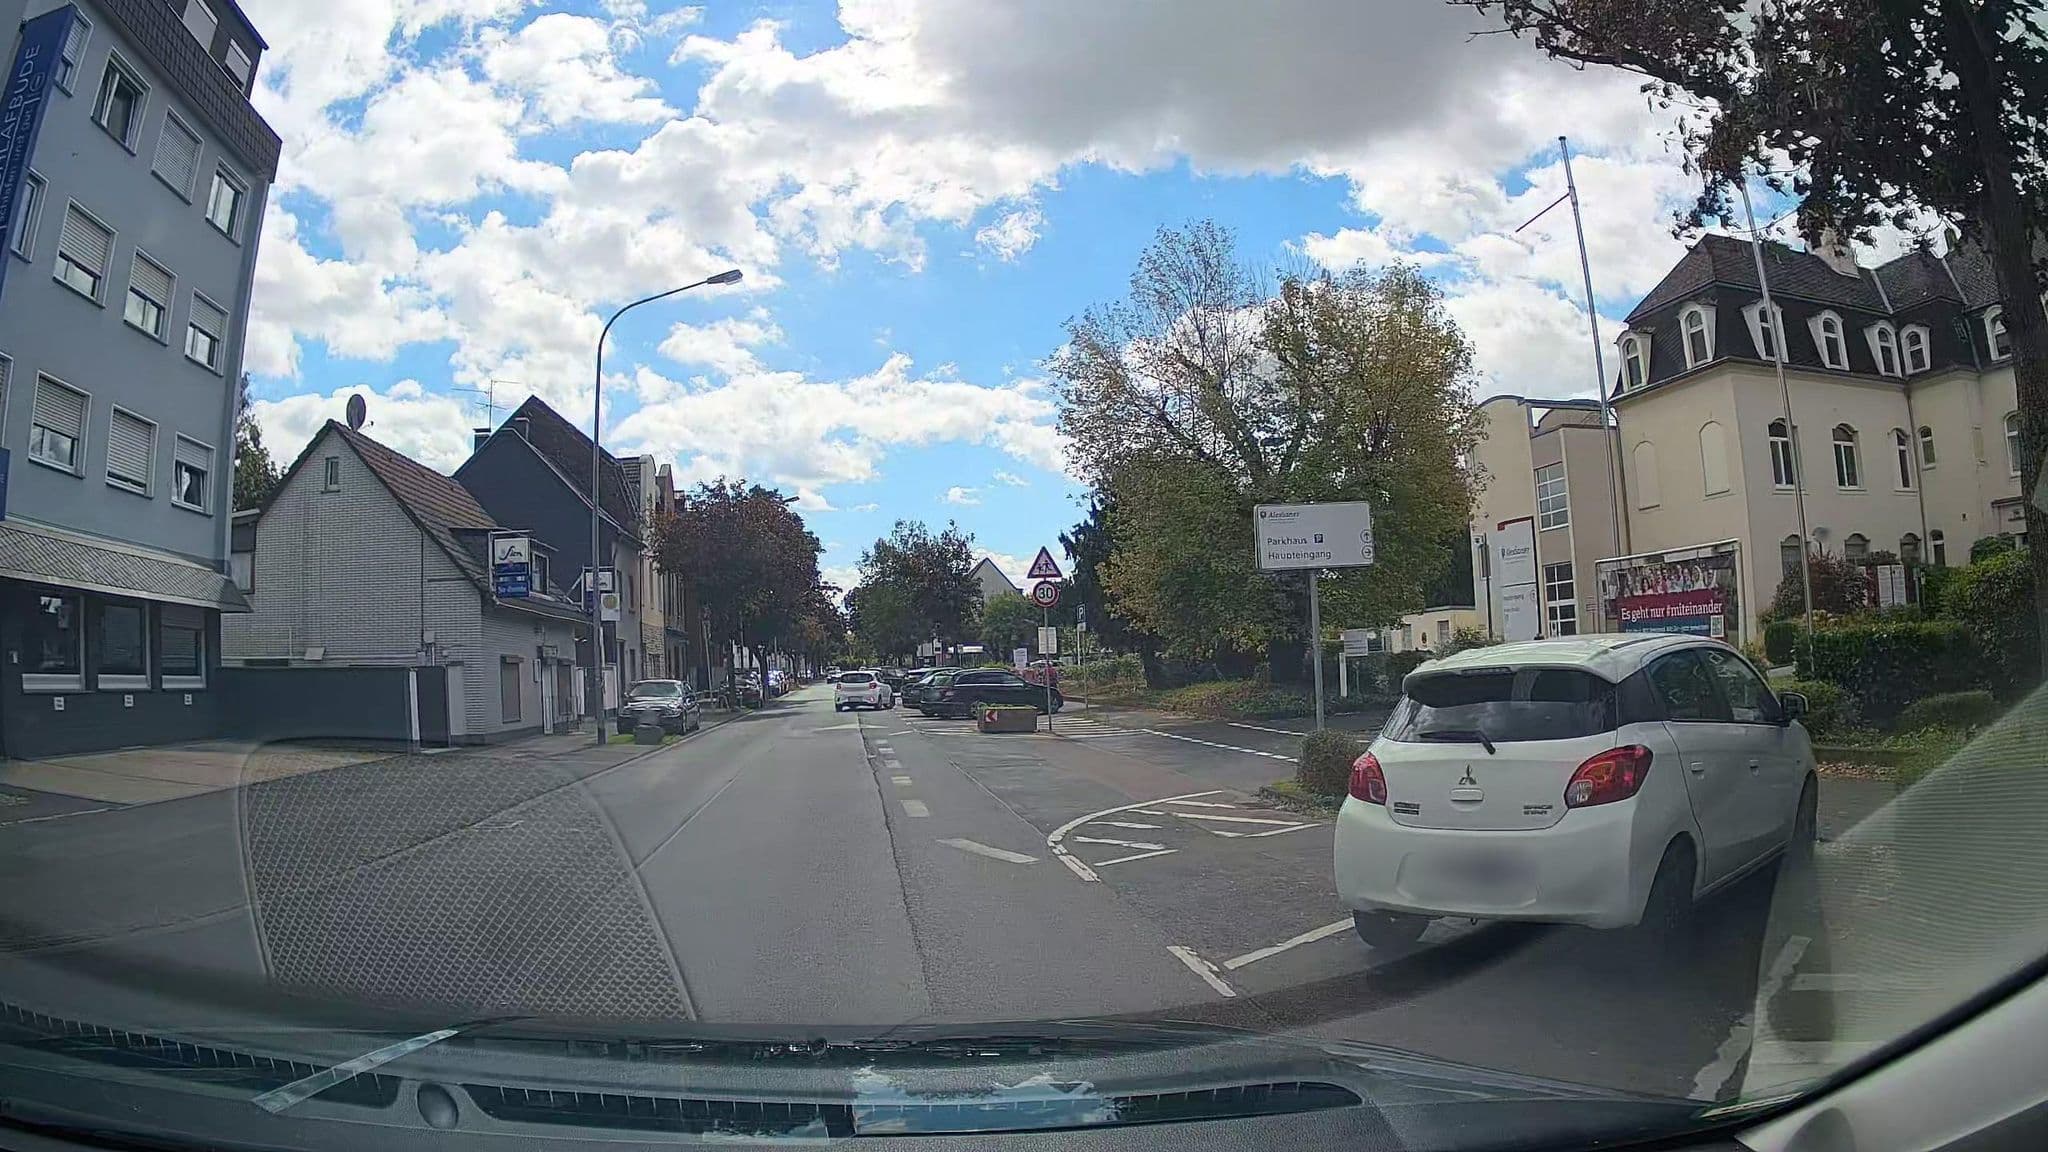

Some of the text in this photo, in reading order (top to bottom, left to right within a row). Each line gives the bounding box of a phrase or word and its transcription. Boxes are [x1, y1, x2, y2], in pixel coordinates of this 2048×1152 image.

[1267, 536, 1307, 545] Parkhaus
[1268, 551, 1331, 560] Haupteingang
[1038, 587, 1054, 599] 30
[1078, 607, 1084, 620] P
[1621, 600, 1722, 622] Es geht nur #miteinander
